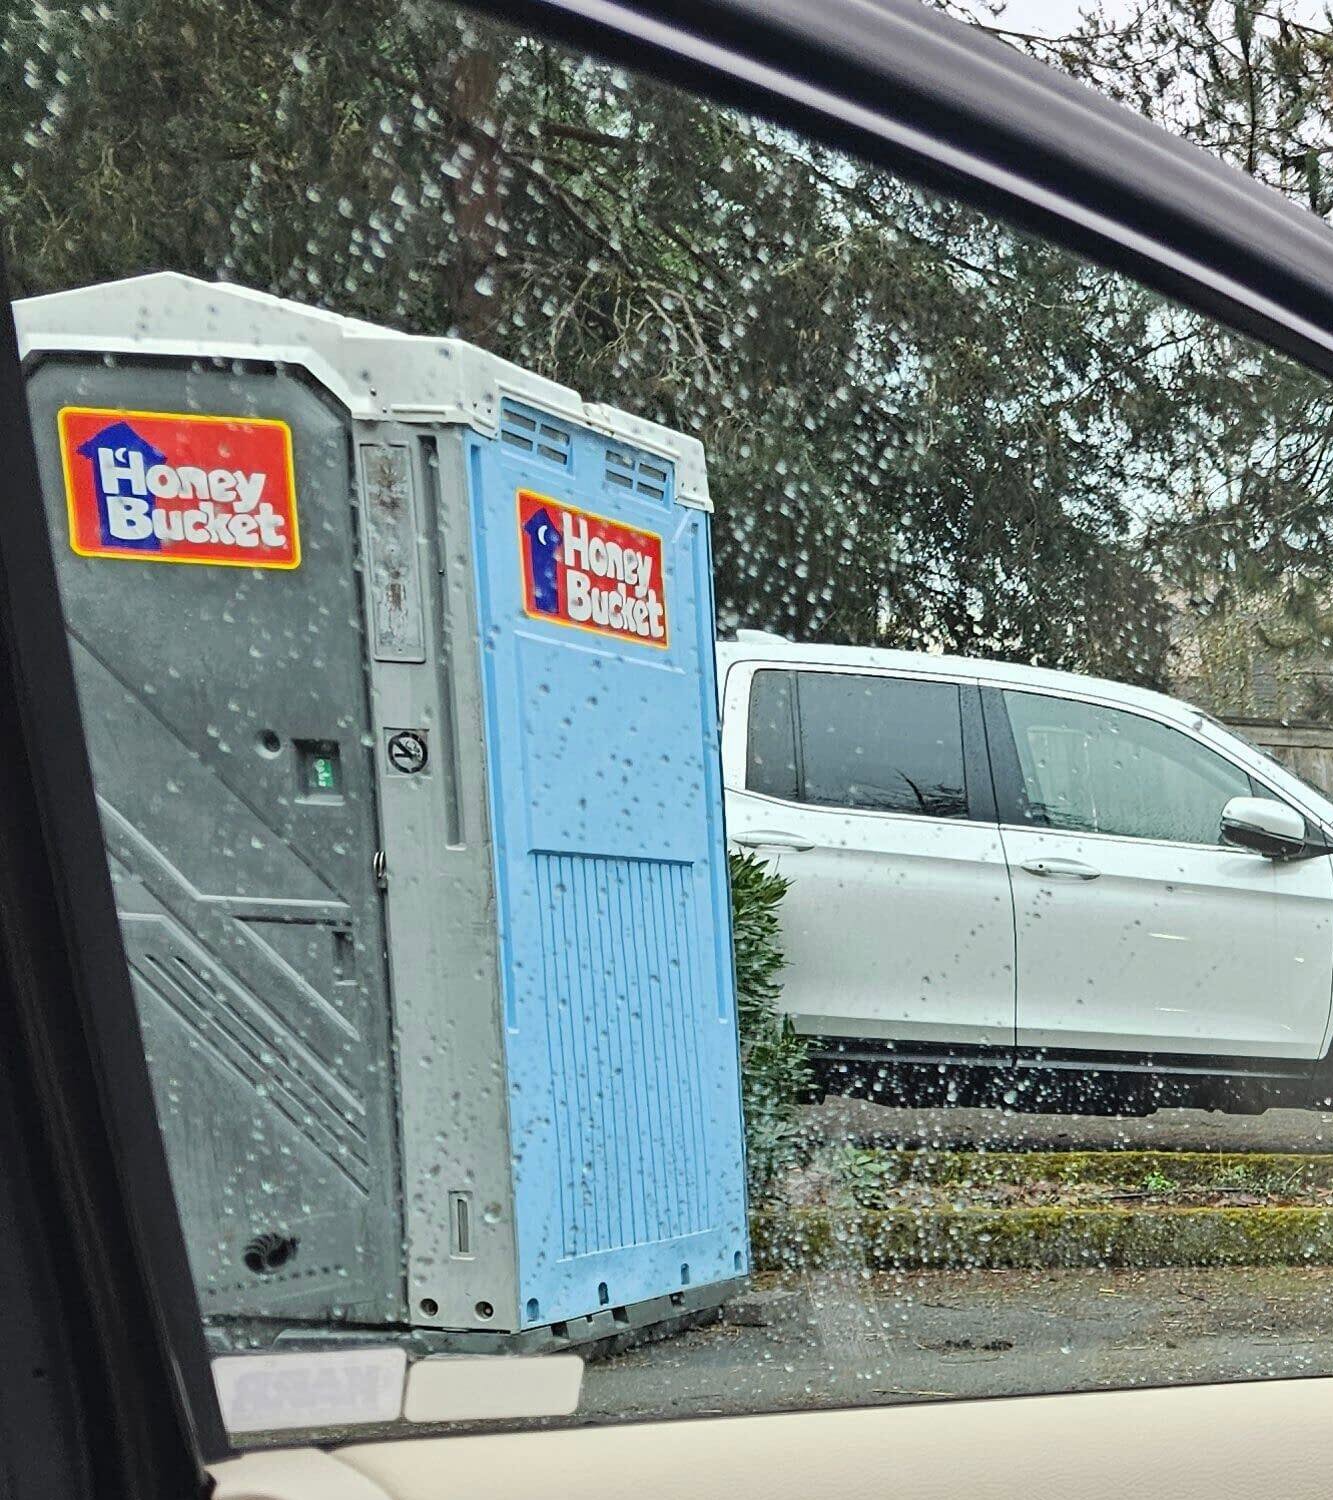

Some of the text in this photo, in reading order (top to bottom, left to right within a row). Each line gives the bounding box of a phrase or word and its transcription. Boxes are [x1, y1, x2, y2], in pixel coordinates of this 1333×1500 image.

[97, 447, 266, 513] Honey
[106, 495, 287, 547] Bucket
[562, 511, 653, 598] Honey
[566, 568, 664, 638] Bucket
